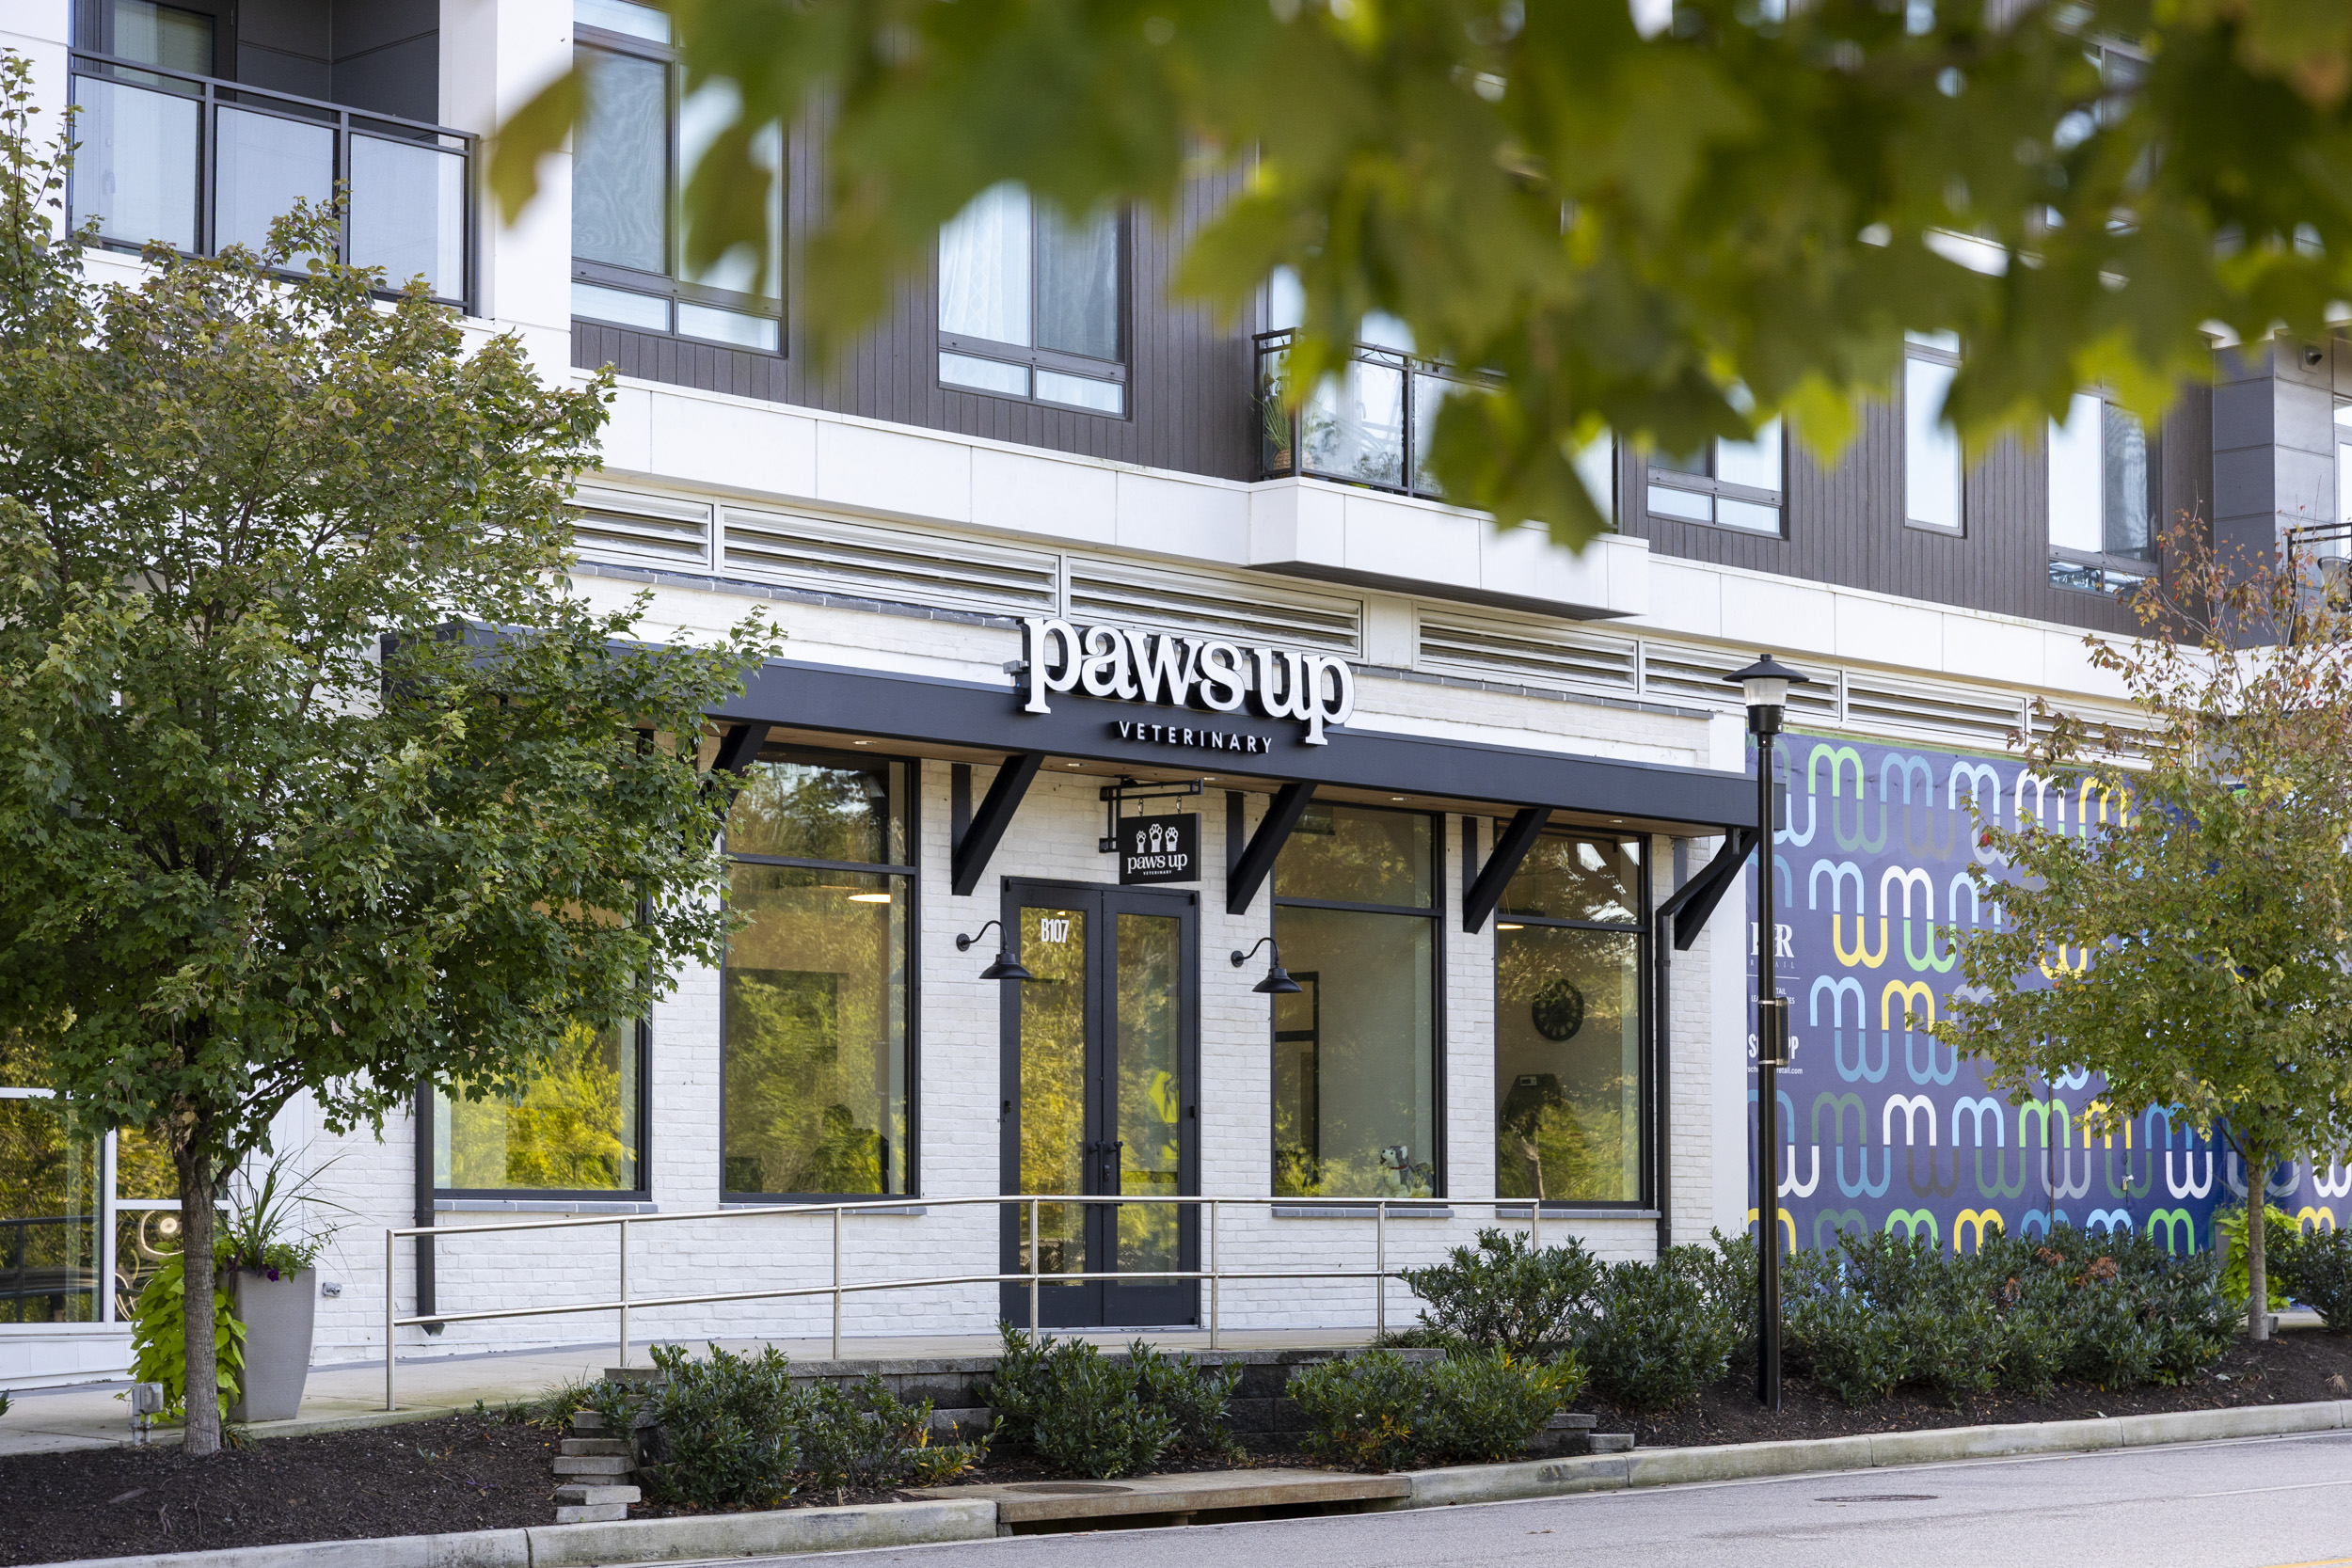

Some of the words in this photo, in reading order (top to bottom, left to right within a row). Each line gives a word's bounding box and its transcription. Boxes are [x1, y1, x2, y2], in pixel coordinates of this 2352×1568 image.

[1022, 615, 1246, 715] paws
[1251, 646, 1356, 745] up
[1118, 720, 1272, 753] VETERINARY
[1126, 855, 1166, 874] paws
[1168, 853, 1188, 871] up
[1041, 917, 1070, 943] B107
